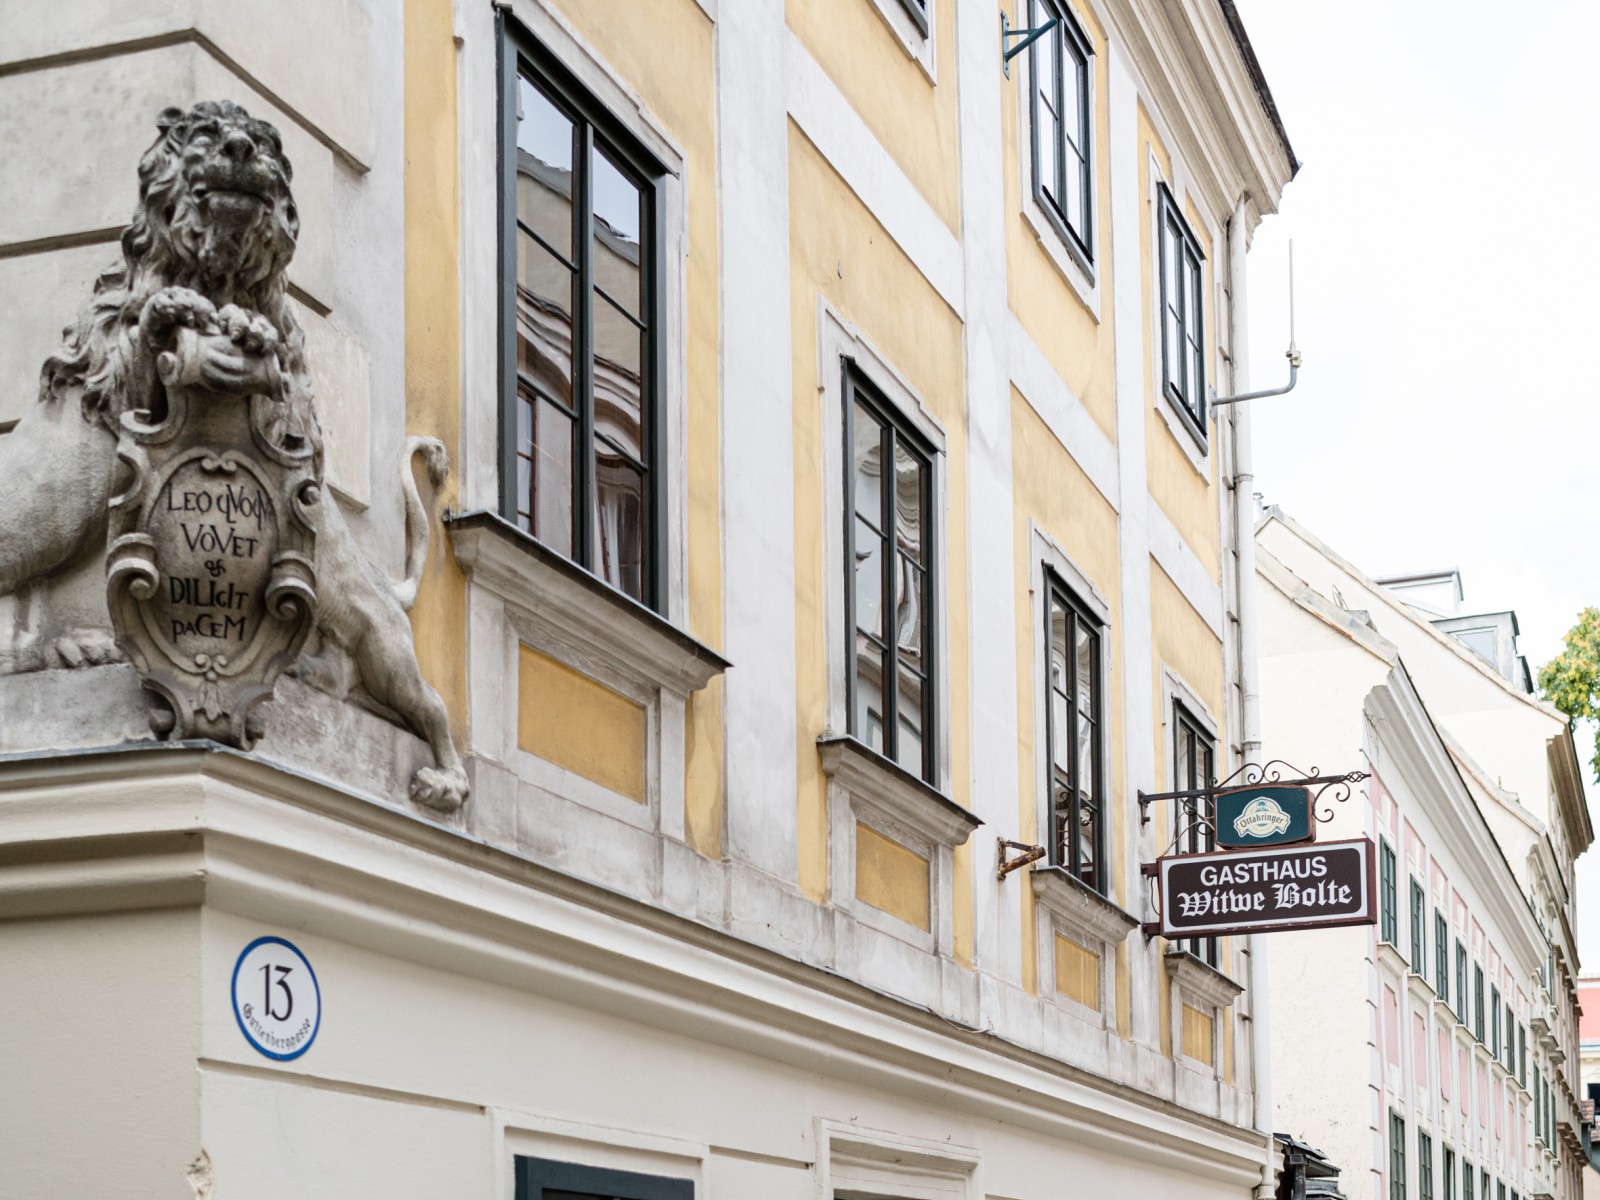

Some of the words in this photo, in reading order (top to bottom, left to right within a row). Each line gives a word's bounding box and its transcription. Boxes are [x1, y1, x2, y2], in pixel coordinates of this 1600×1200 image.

[167, 482, 212, 515] LEO
[1240, 813, 1284, 828] Ottakringer
[1200, 856, 1327, 886] GASTHAUS
[1177, 888, 1265, 918] Witwe
[1271, 879, 1353, 910] Bolte
[258, 963, 294, 1022] 13
